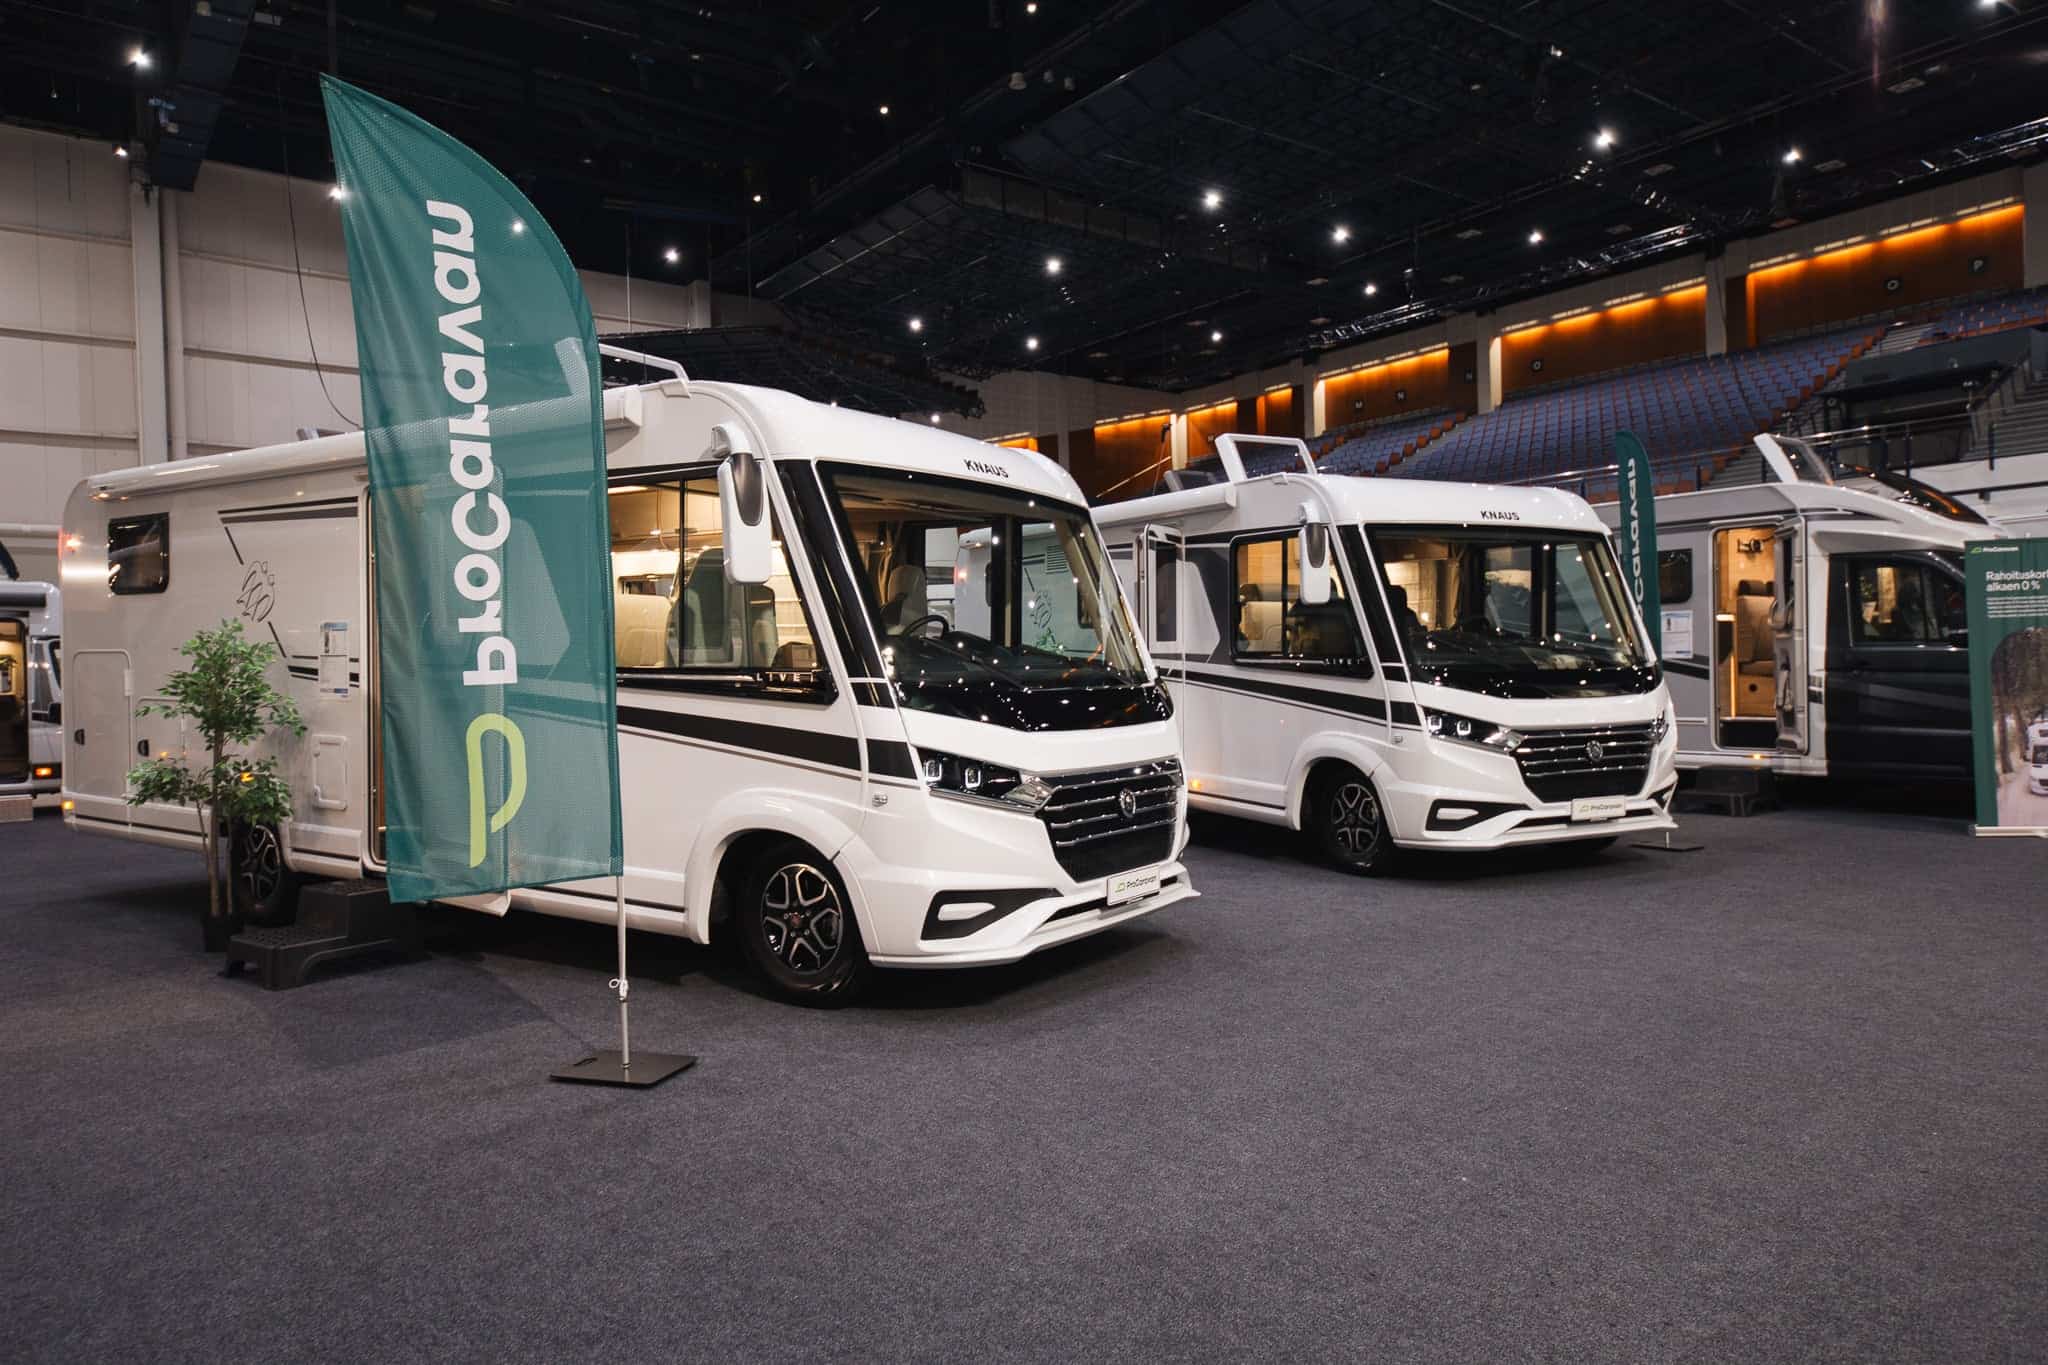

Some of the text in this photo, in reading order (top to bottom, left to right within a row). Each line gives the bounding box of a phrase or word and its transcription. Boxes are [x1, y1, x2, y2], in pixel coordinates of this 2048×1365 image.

[964, 459, 1009, 478] KNAUS
[1480, 510, 1520, 520] KNAUS
[1986, 580, 2041, 592] alkaen 0 %
[1126, 875, 1156, 888] ProCaravan
